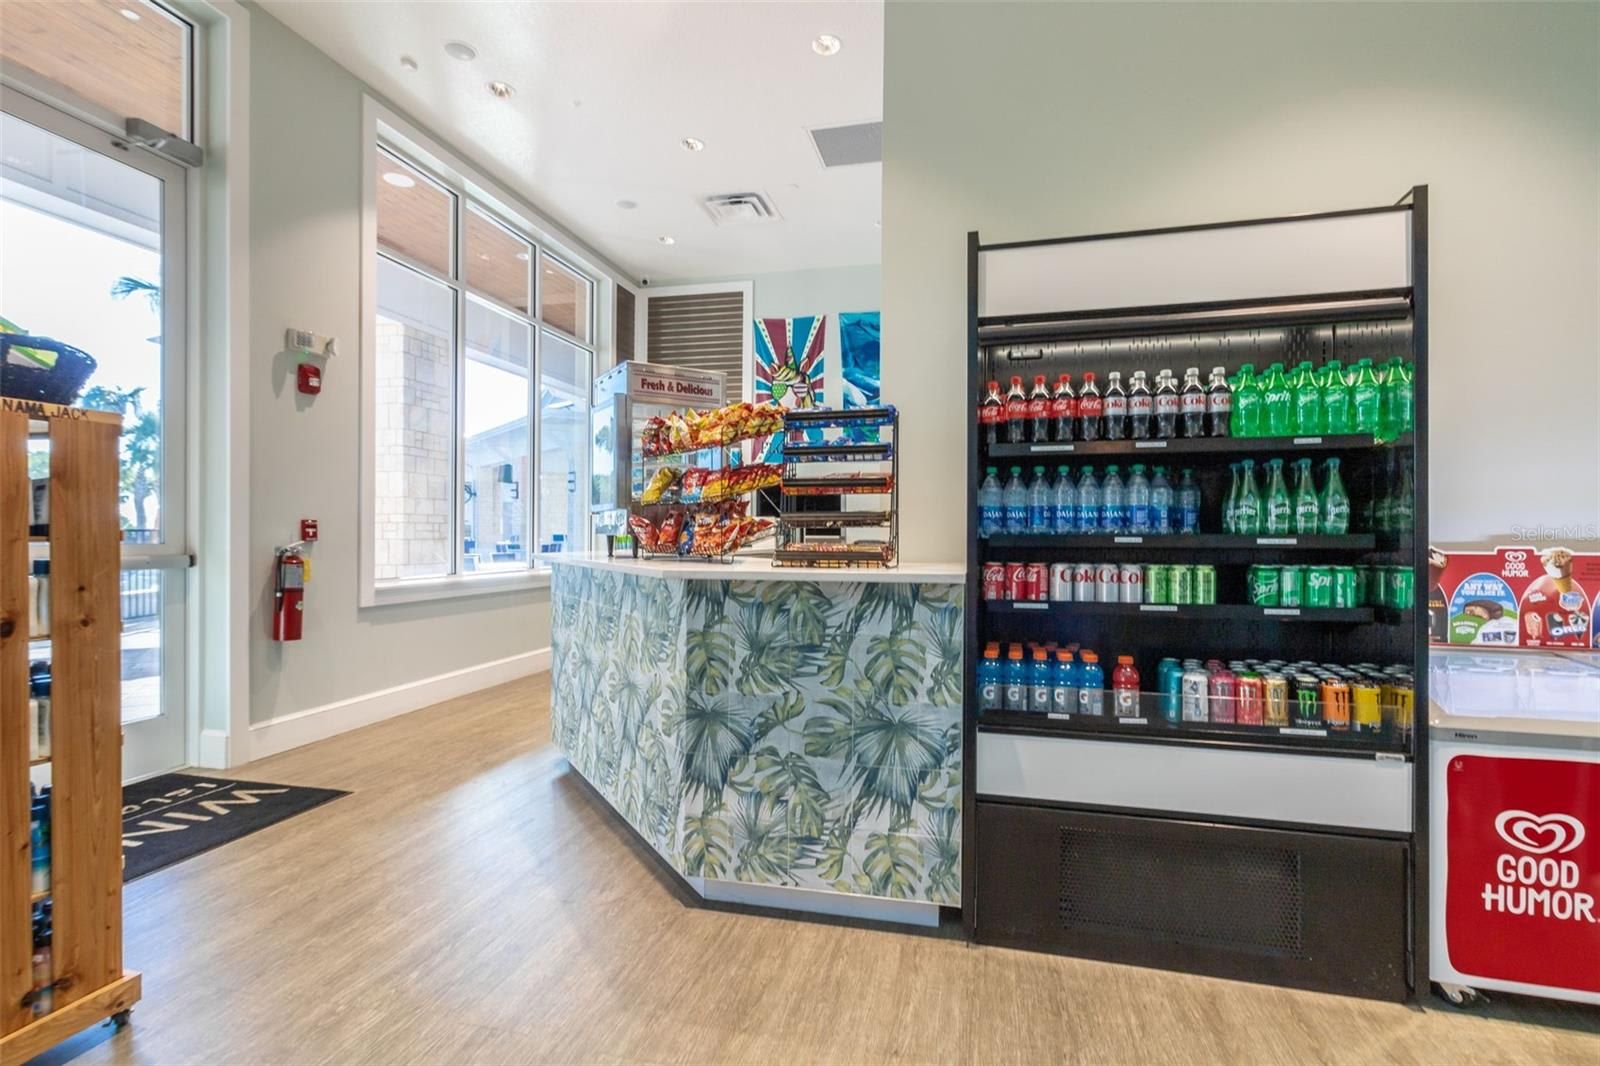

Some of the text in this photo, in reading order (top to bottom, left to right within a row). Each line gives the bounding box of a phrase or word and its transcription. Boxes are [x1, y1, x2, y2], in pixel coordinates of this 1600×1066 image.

[641, 378, 713, 396] Fresh & Delicious
[50, 407, 89, 420] JACK
[1501, 569, 1529, 578] HUMOR
[1504, 561, 1526, 571] GOOD
[1496, 853, 1580, 889] GOOD
[1481, 883, 1597, 923] HUMOR
